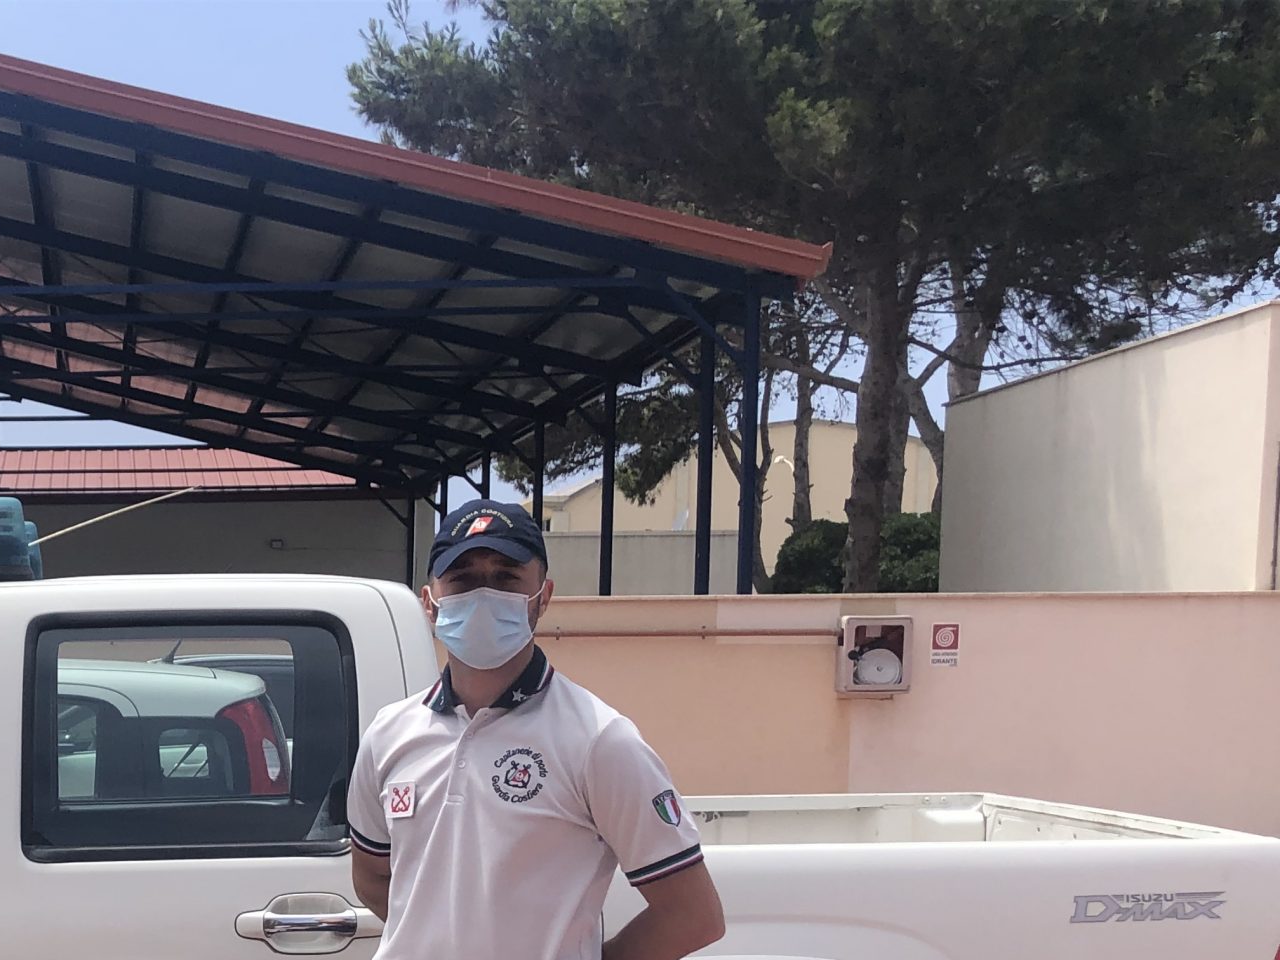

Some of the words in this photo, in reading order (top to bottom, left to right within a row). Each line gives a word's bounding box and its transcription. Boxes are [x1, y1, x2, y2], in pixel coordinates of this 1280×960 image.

[451, 510, 479, 537] GUARDIA
[491, 775, 510, 802] Guardia
[510, 782, 543, 803] Costiera
[1125, 893, 1175, 903] ISUZU
